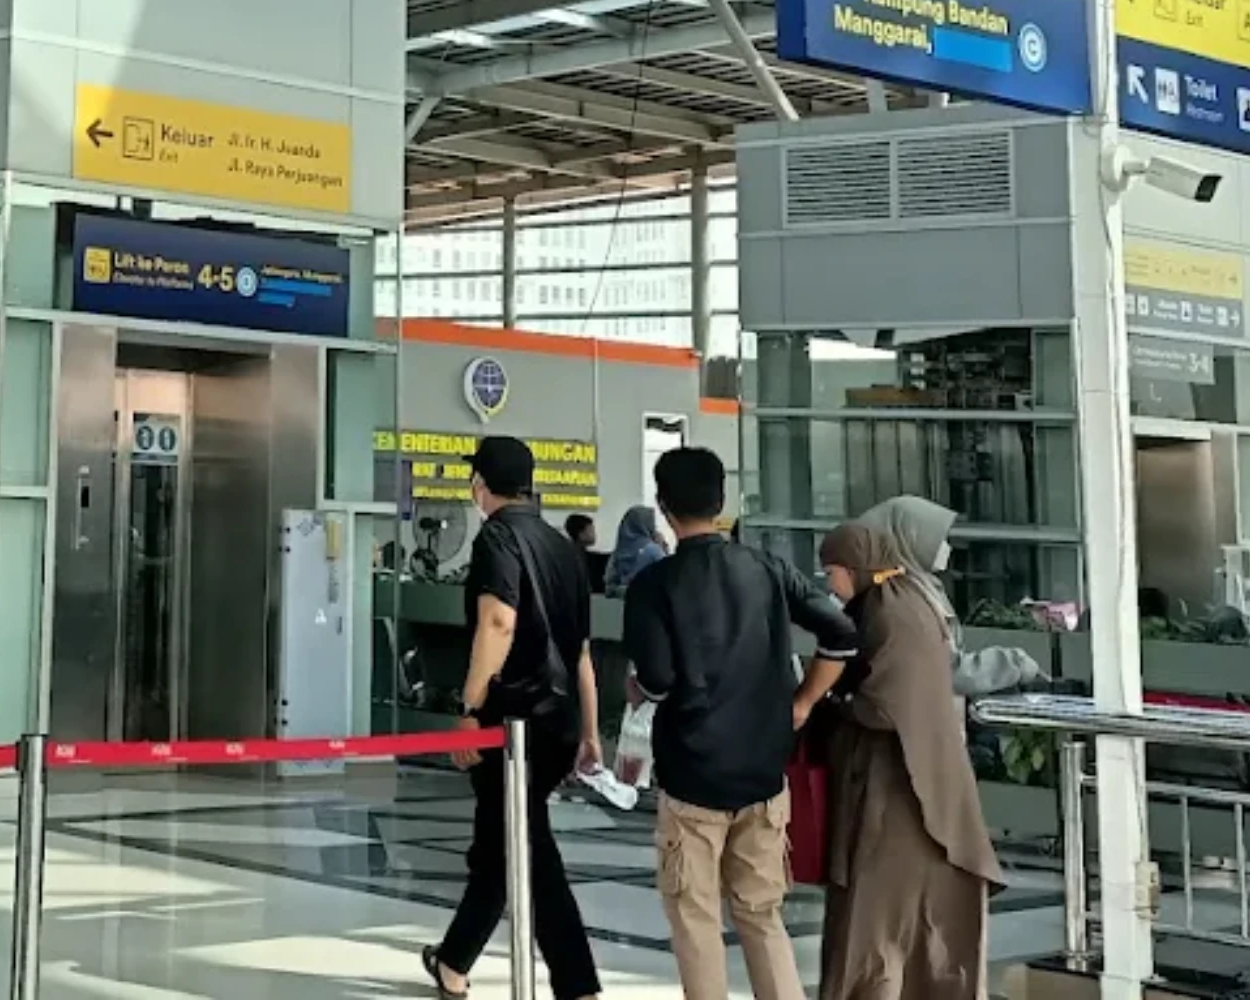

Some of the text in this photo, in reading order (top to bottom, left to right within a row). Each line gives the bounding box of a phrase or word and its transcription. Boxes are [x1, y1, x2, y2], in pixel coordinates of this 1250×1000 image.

[834, 4, 932, 54] Manggarai,
[1184, 75, 1218, 101] Toilet
[161, 123, 215, 149] Keluar
[276, 139, 321, 160] Juanda
[245, 160, 274, 179] Raya
